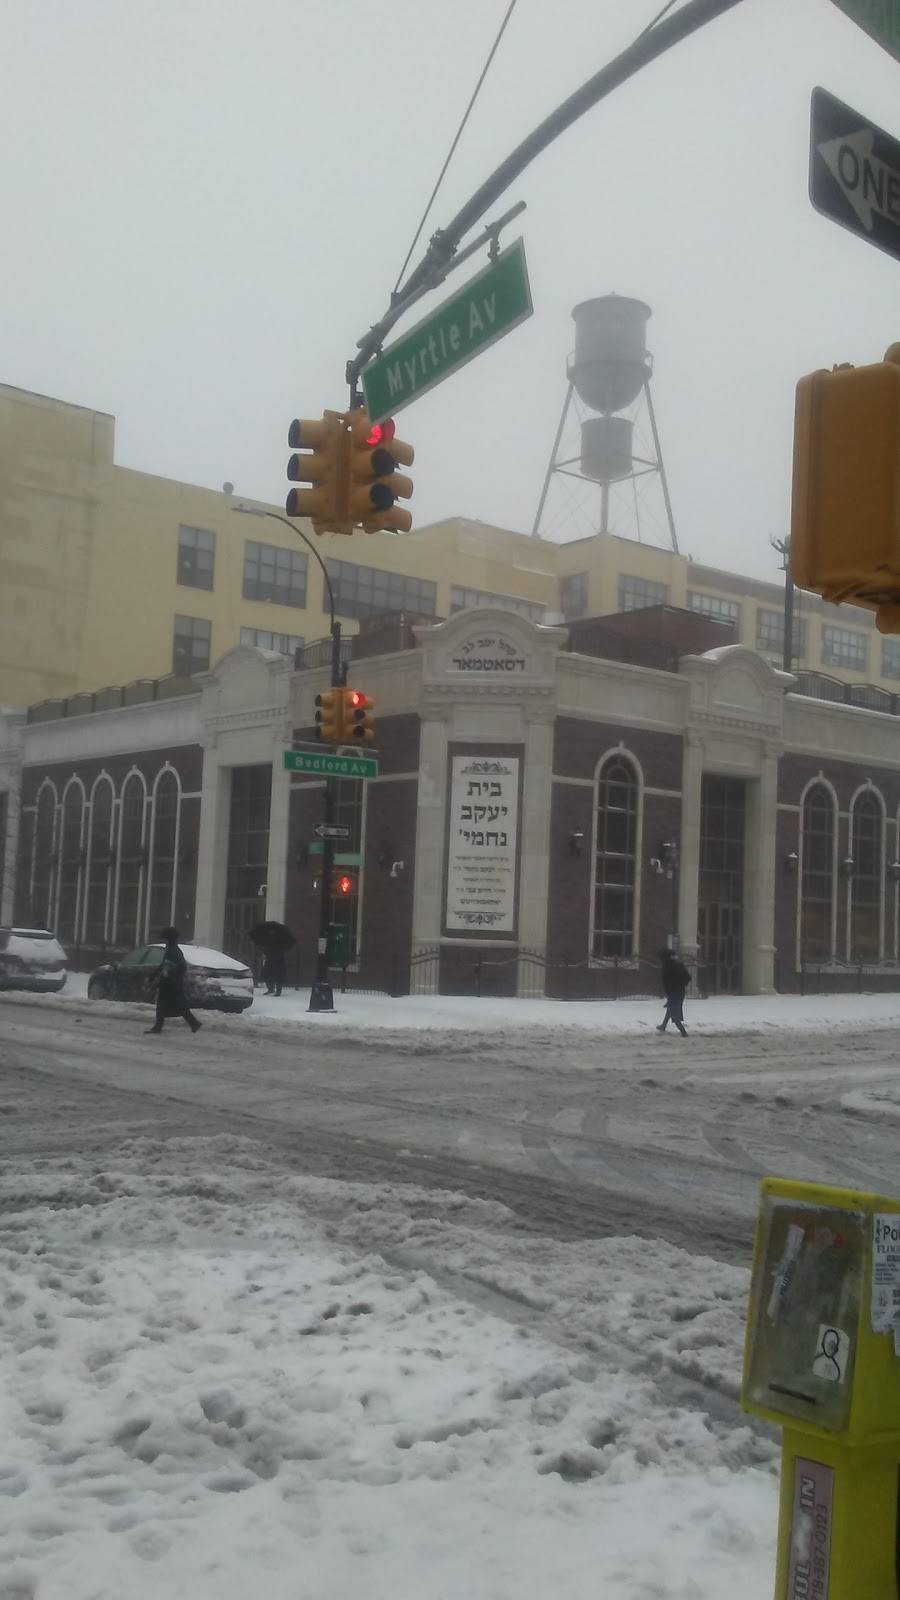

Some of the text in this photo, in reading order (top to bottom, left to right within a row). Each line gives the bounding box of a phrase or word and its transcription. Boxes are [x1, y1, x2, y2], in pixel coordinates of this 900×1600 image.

[838, 144, 900, 217] ONE
[386, 324, 461, 397] Myrtle
[452, 658, 525, 671] דסאטמאר
[295, 757, 348, 772] Bedford
[466, 781, 502, 796] בית
[460, 805, 508, 824] יעקב
